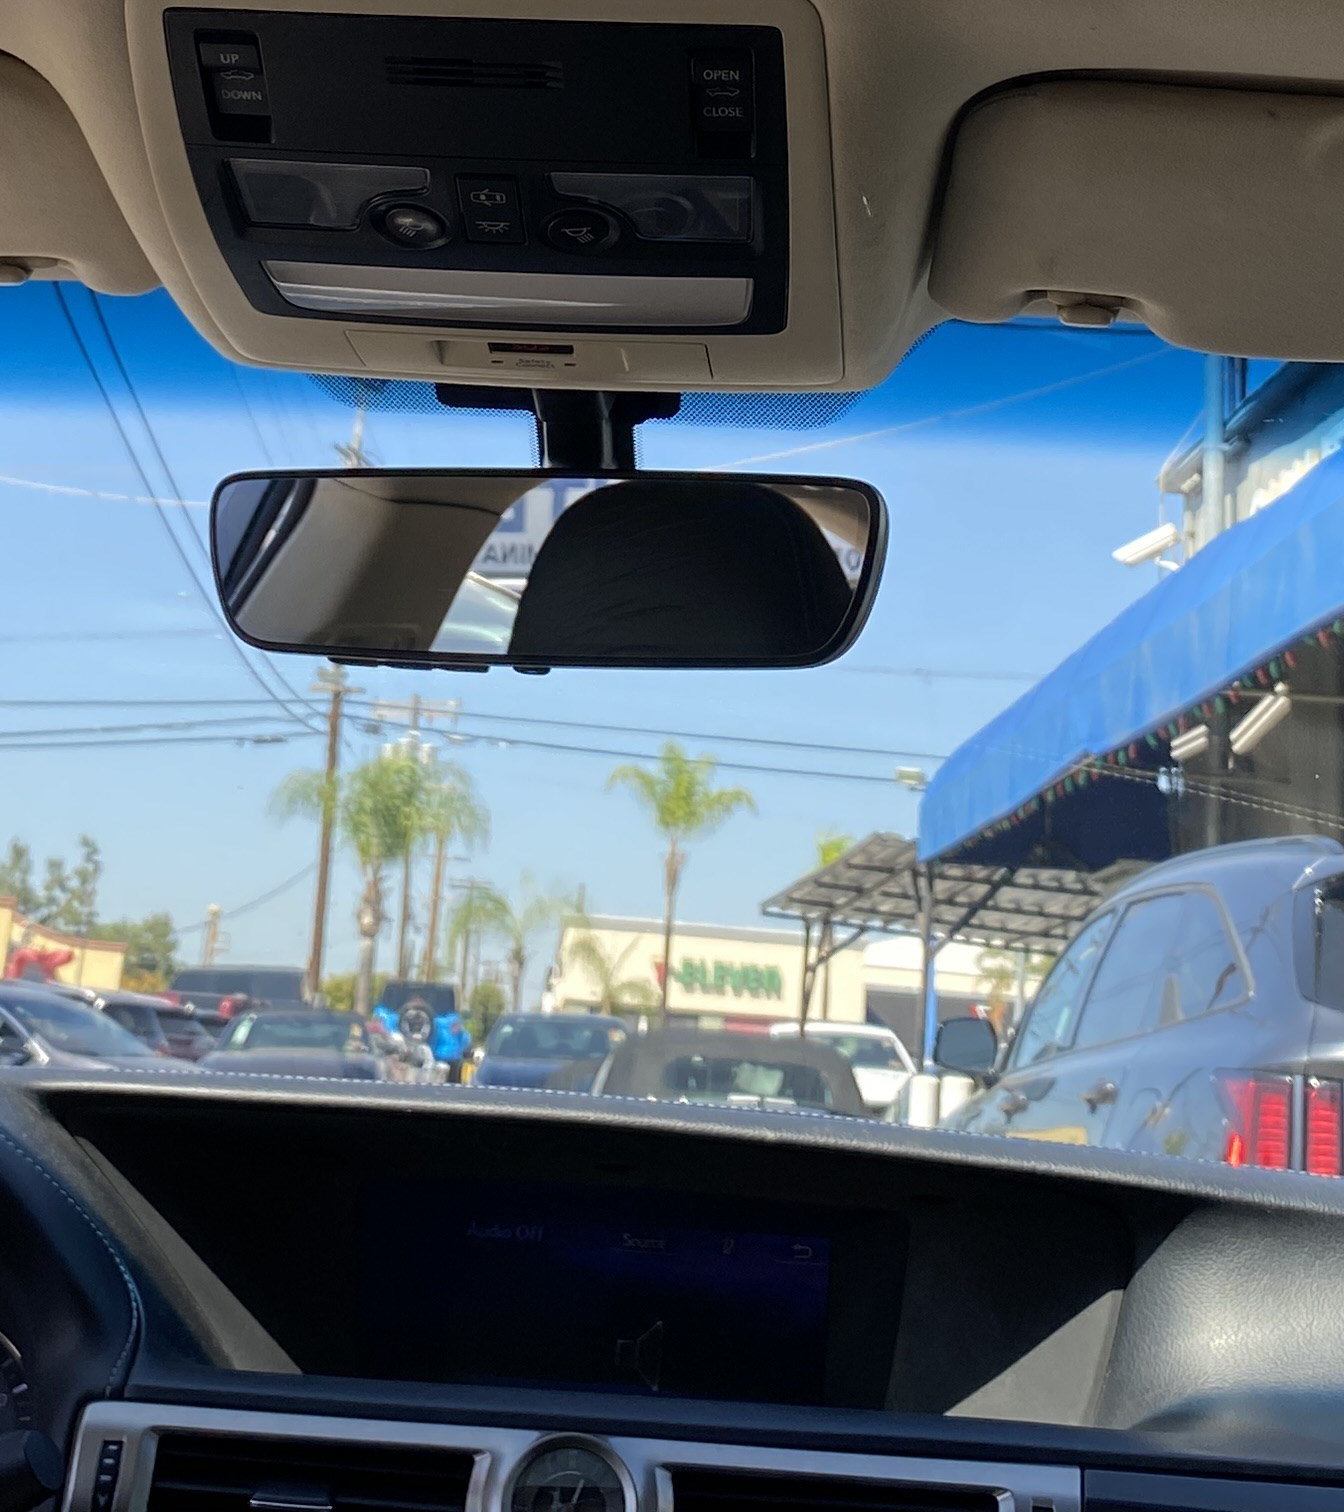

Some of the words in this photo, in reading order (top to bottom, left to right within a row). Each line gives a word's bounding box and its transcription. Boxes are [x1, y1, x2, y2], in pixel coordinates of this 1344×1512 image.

[219, 52, 240, 65] UP
[703, 69, 740, 80] OPEN
[221, 88, 263, 101] DOWN
[702, 106, 744, 118] CLOSE
